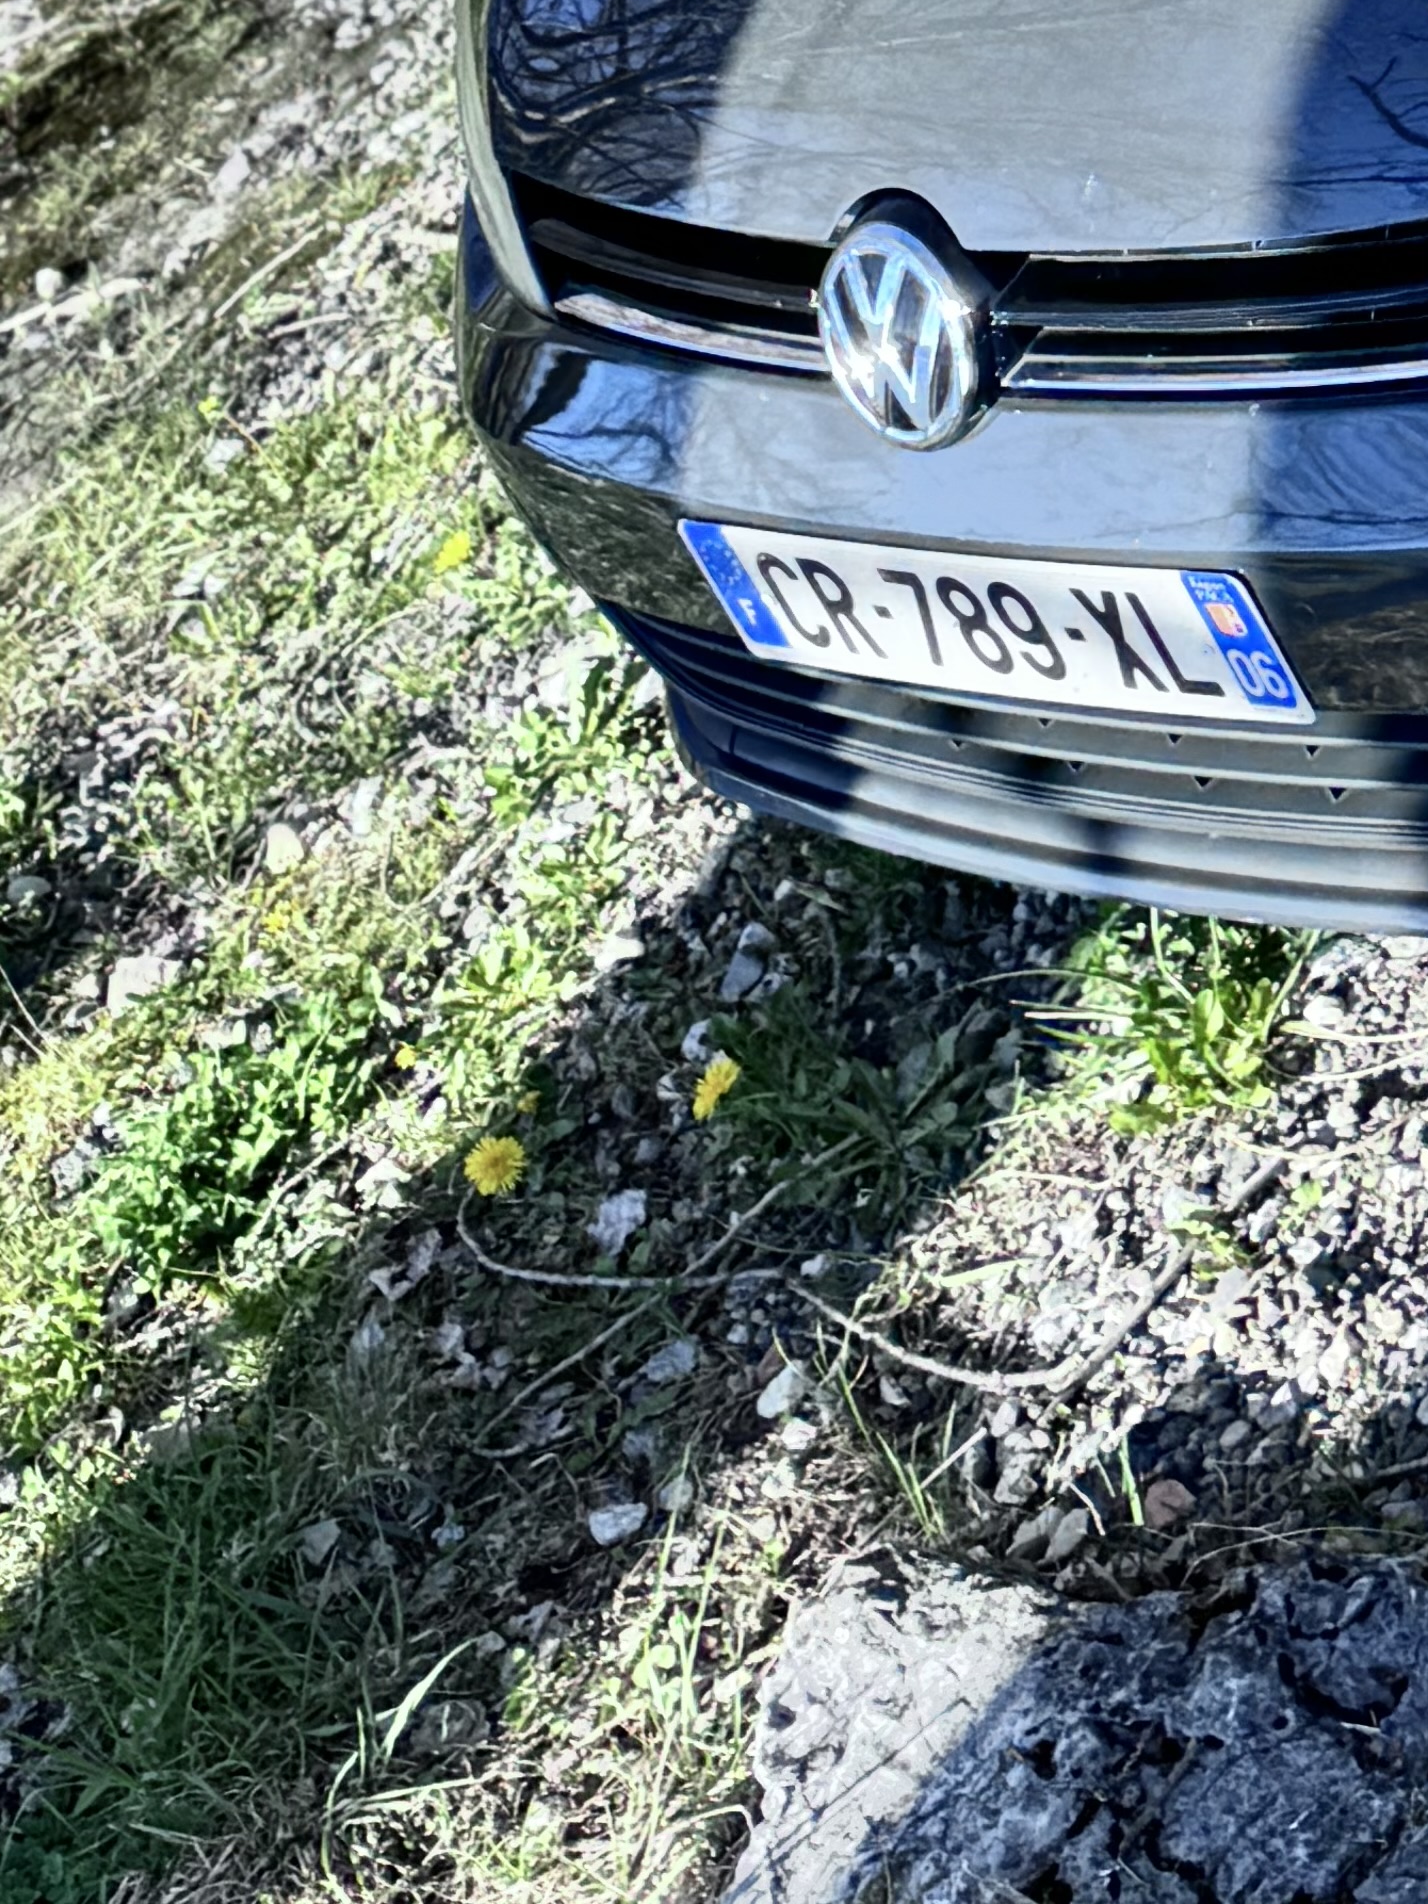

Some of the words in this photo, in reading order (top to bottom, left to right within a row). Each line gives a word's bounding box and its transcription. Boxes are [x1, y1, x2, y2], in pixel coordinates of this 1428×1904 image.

[736, 597, 758, 626] F
[756, 551, 1226, 698] CR-789-XL
[1226, 648, 1290, 699] 06
